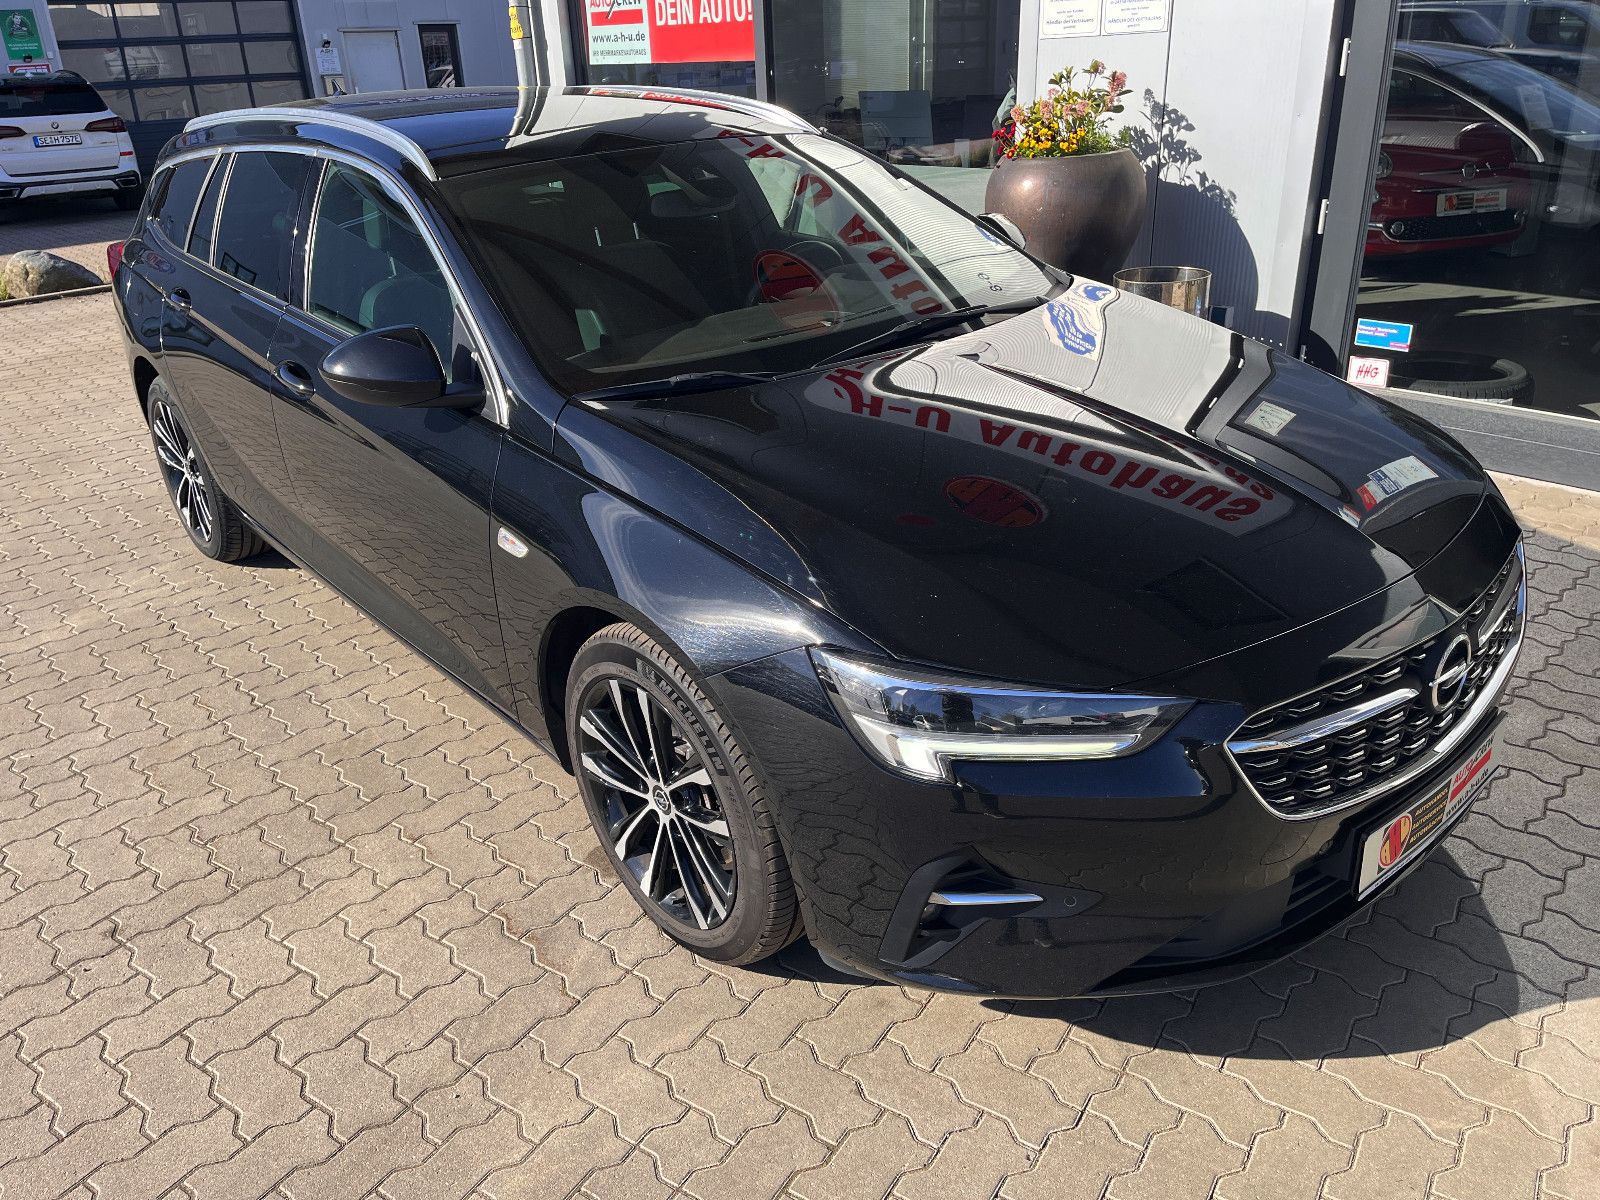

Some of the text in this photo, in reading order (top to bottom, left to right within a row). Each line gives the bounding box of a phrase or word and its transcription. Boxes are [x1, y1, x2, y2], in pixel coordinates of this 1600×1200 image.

[655, 0, 753, 26] DEIN AUTO!
[592, 31, 646, 43] www.a-h-u.de
[1355, 363, 1381, 379] HHG
[658, 678, 725, 770] MICHELIN
